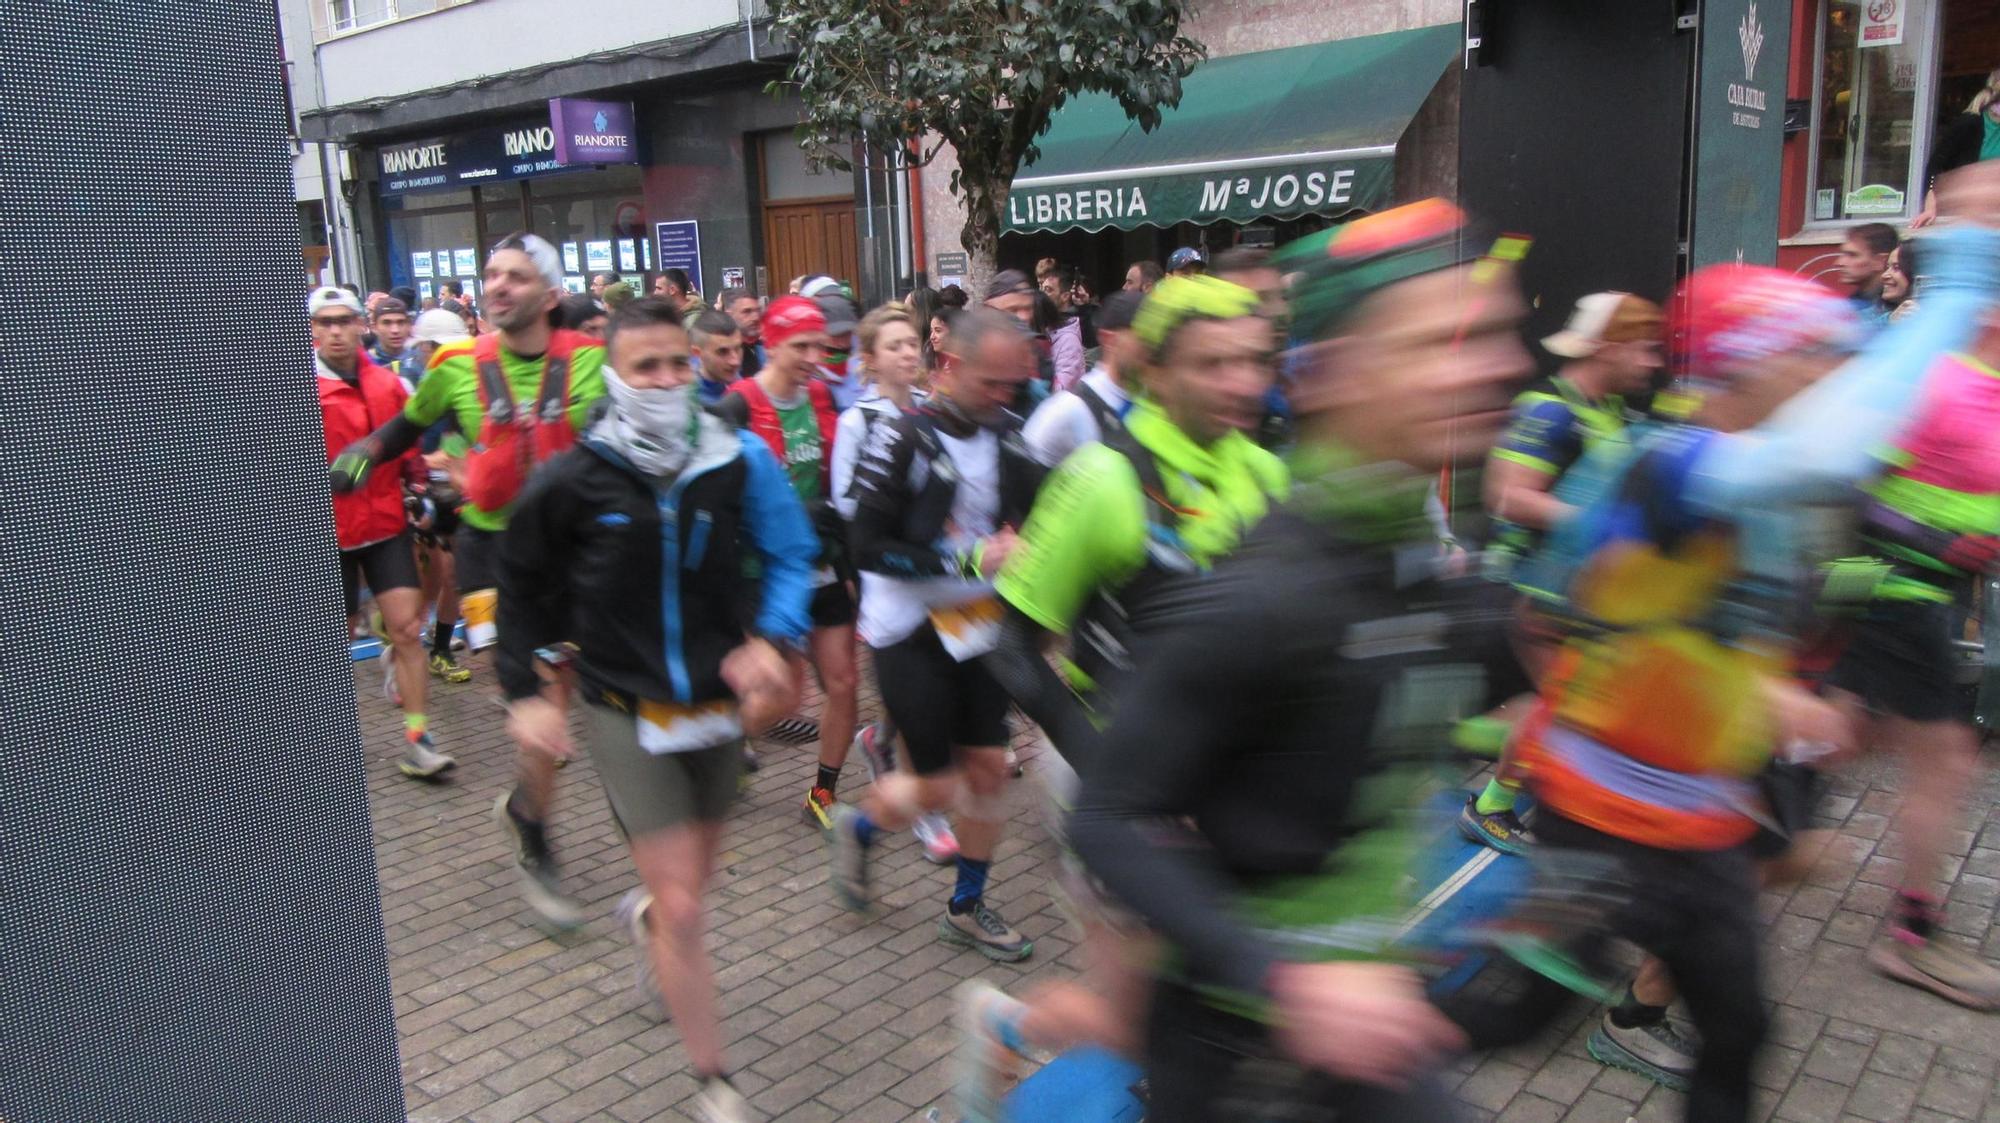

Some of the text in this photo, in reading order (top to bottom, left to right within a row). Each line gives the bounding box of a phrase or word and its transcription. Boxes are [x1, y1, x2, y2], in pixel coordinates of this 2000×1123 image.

[1728, 83, 1766, 111] CAJA RURAL
[575, 134, 629, 147] RIANORTE
[383, 144, 447, 174] RIANORTE
[1010, 187, 1147, 224] LIBRERIA
